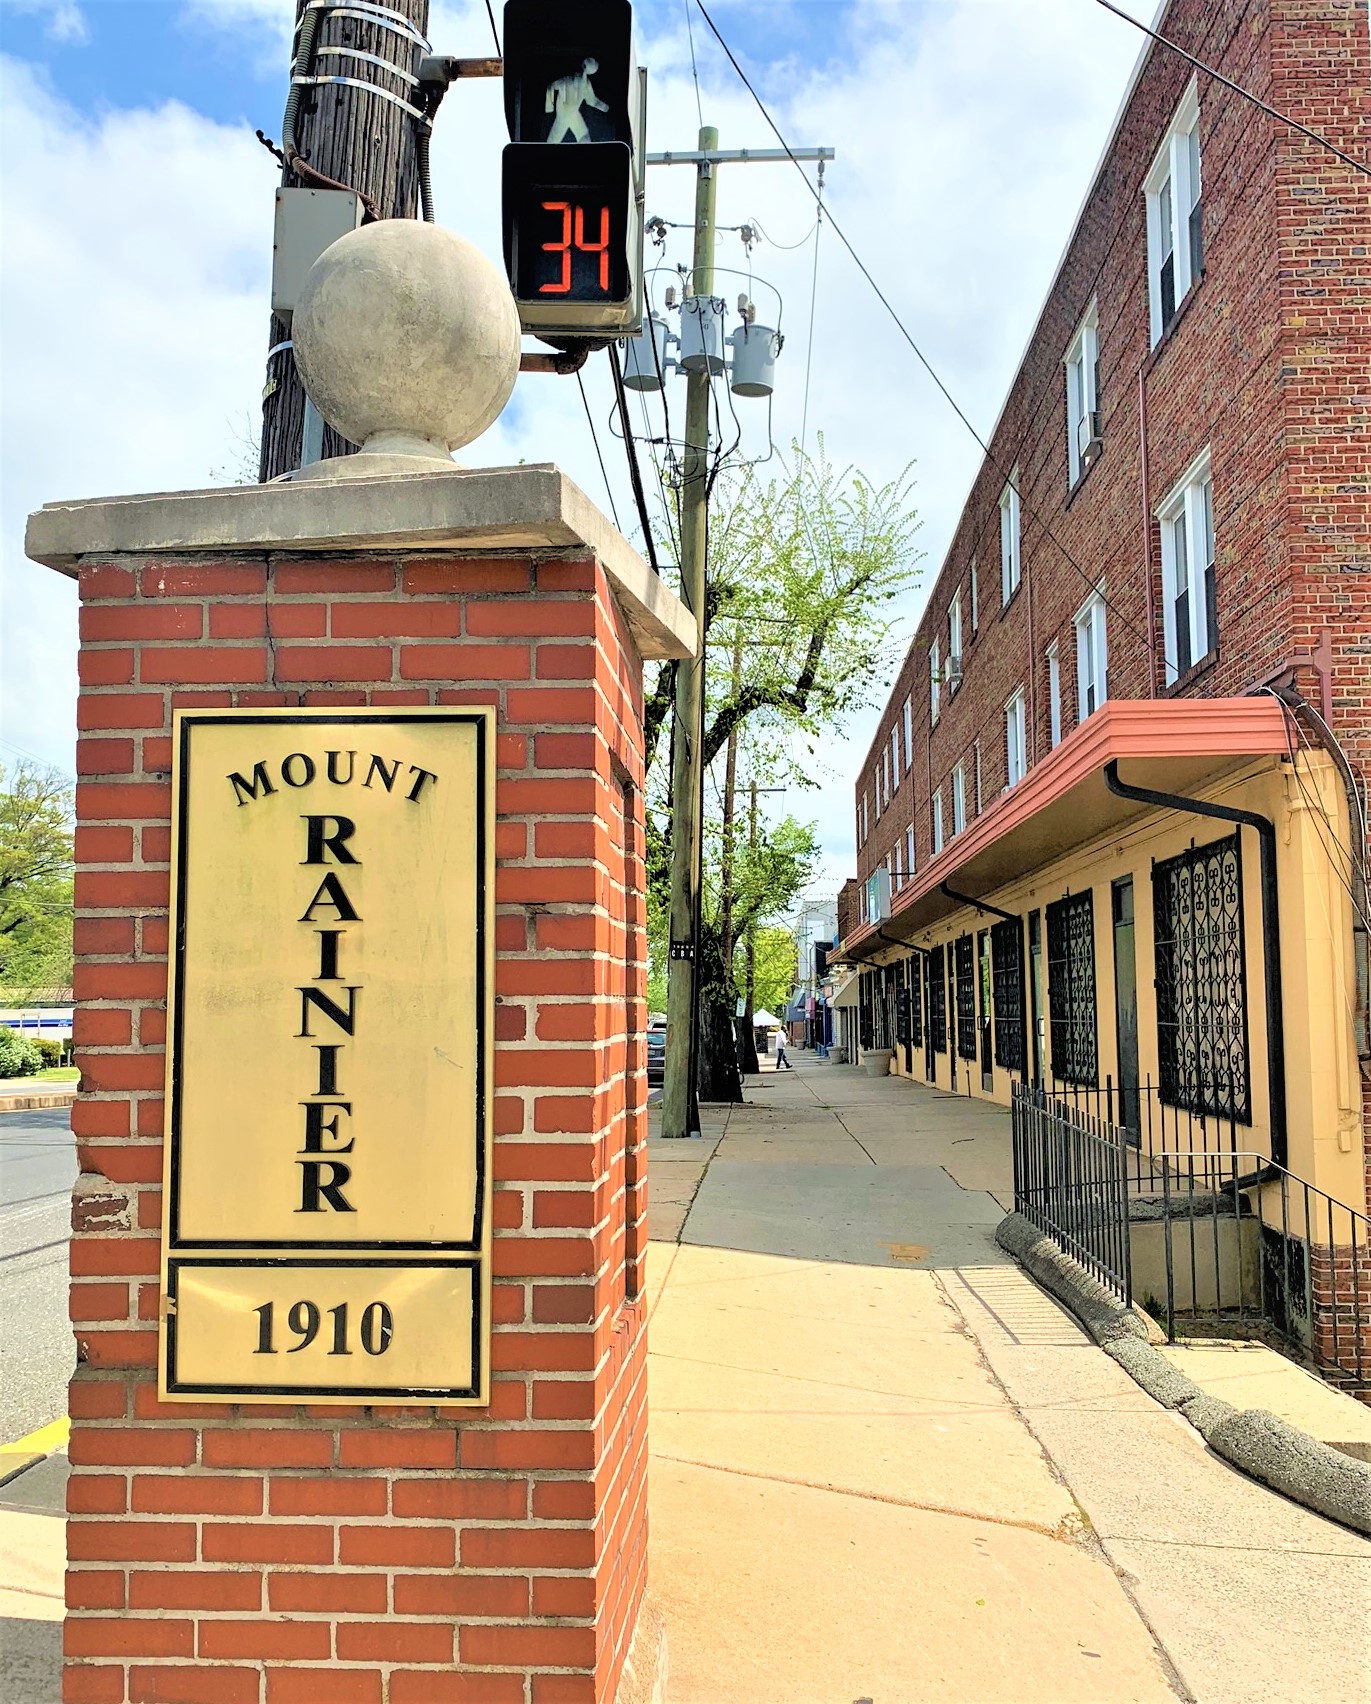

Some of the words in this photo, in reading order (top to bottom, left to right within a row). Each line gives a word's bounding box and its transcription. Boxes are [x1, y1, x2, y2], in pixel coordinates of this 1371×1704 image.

[539, 201, 609, 293] 34
[226, 751, 438, 807] MOUNT
[293, 815, 363, 1213] RAINIER
[252, 1301, 394, 1356] 1910
